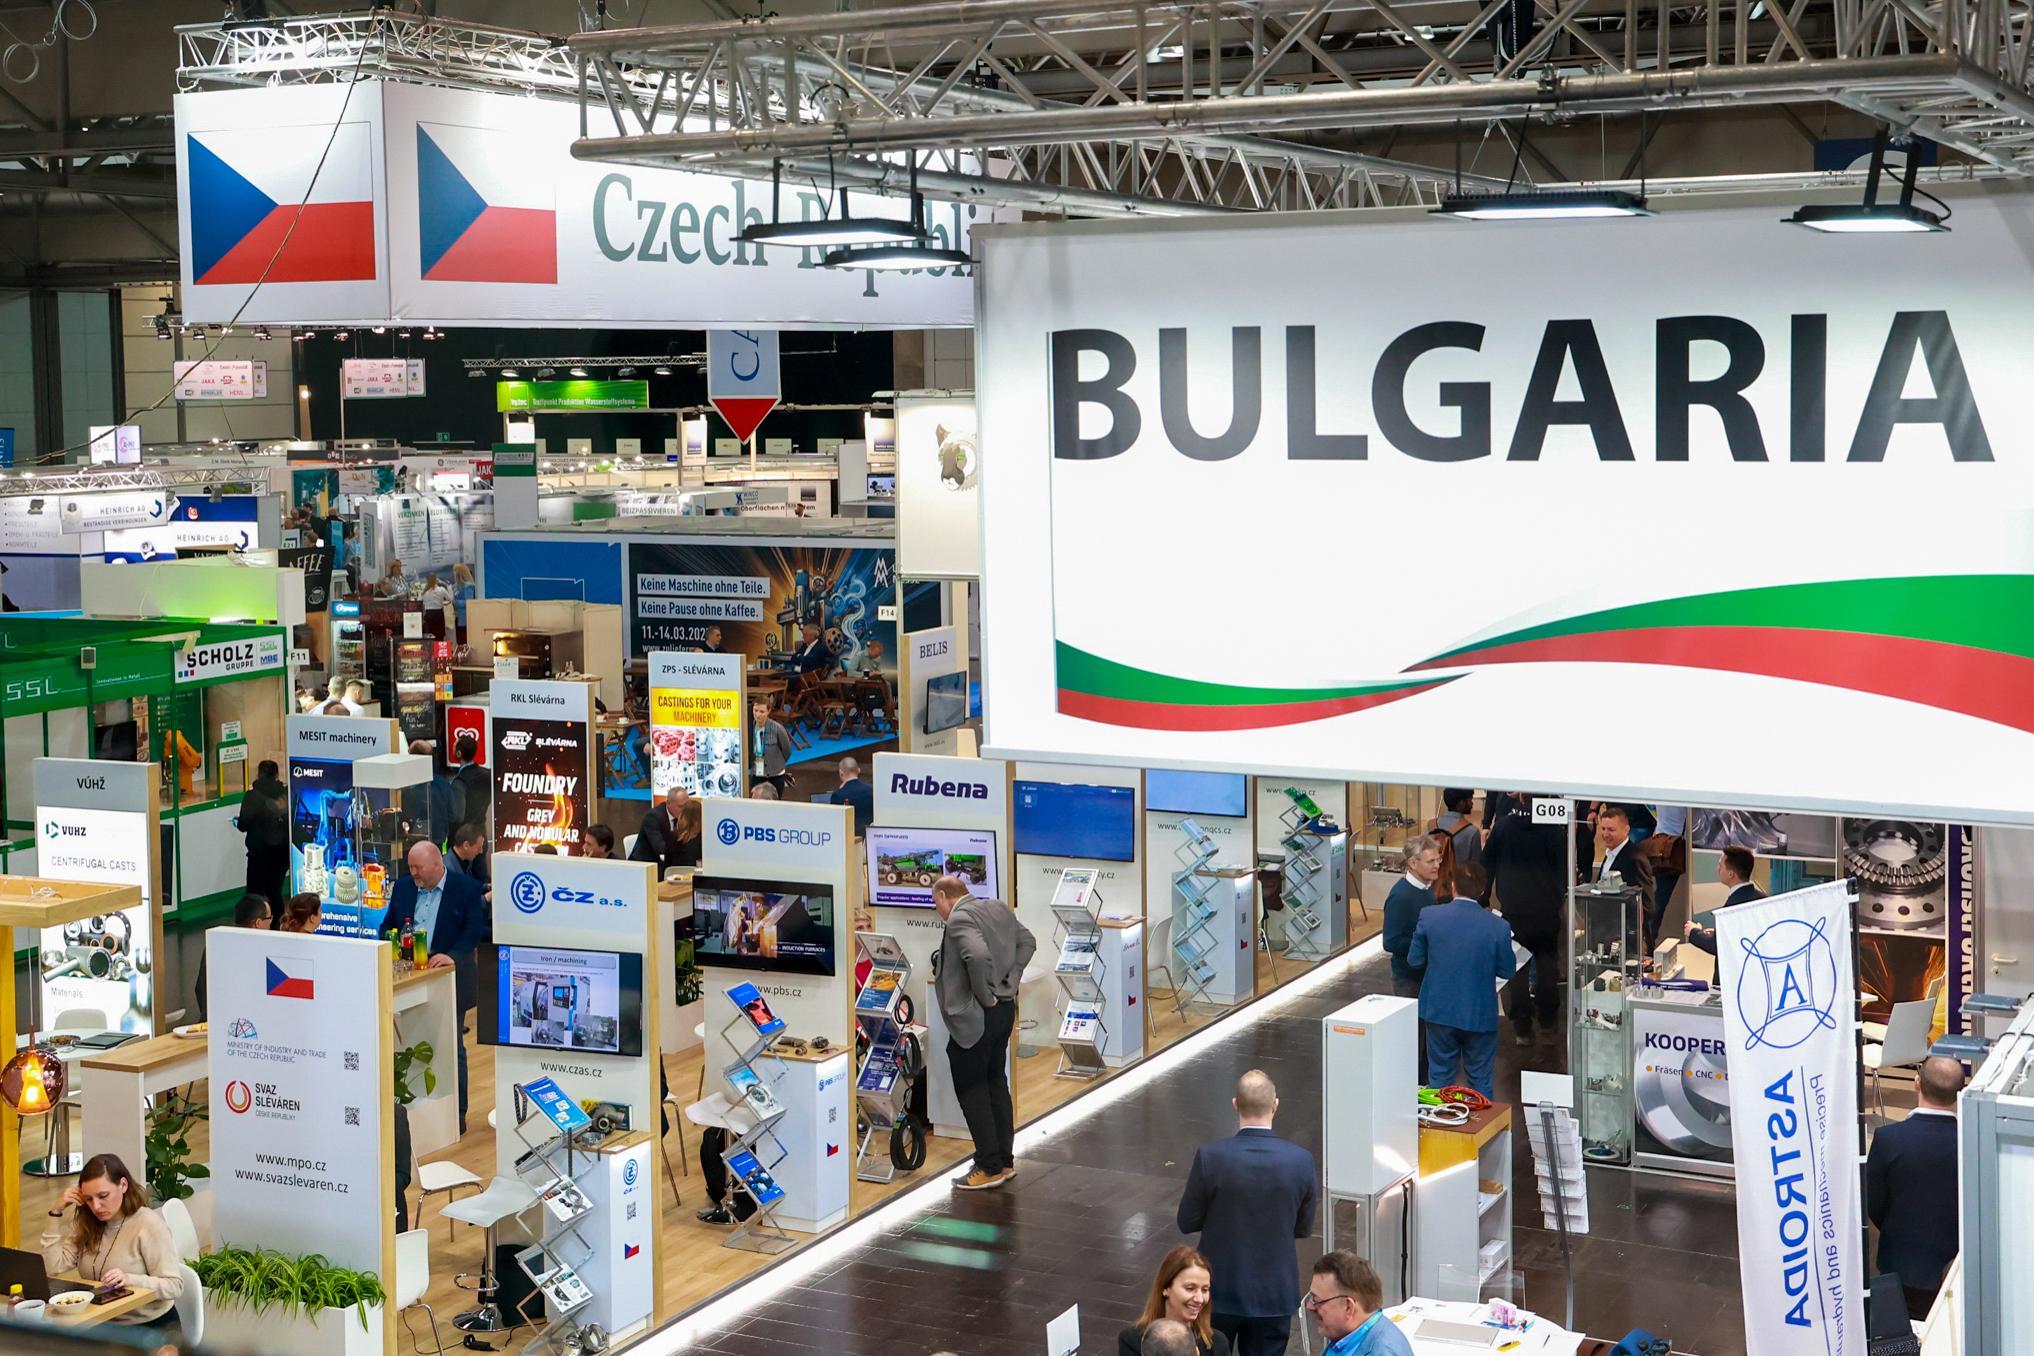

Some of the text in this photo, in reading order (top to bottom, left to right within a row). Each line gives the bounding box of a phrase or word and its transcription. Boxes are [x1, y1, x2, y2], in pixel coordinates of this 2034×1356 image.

[594, 172, 768, 267] Czech
[1051, 310, 1995, 462] BULGARIA
[100, 505, 135, 515] HEINRICH
[177, 534, 215, 542] HEINRICH
[640, 577, 766, 594] Keine Maschine ohne Teile.
[641, 601, 759, 617] Keine Pause ohne Kaffee.
[641, 625, 708, 641] 11.-14.03.202
[187, 643, 254, 669] SCHOLZ
[290, 652, 306, 662] F11
[920, 640, 948, 659] BELIS
[226, 660, 254, 671] GRUPPE
[662, 665, 676, 674] ZPS
[684, 664, 725, 676] SLÉVÁRNA
[7, 678, 59, 701] SSL
[511, 694, 565, 705] RKL Slévárna
[658, 696, 732, 710] CASTINGS FOR YOUR
[674, 711, 717, 724] MACHINERY
[299, 731, 377, 747] MESIT machinery
[535, 737, 577, 748] SLÉVÁRNA
[303, 769, 324, 778] MESIT
[77, 774, 105, 791] VÚHŽ
[502, 772, 578, 797] FOUNDRY
[891, 773, 989, 800] Rubena
[527, 807, 556, 824] GREY
[1536, 804, 1565, 817] G08
[62, 825, 87, 837] VUHZ
[504, 824, 527, 838] AND
[744, 826, 831, 847] PBS GROUP
[52, 856, 138, 872] CENTRIFUGAL CASTS
[552, 886, 628, 908] ČZ a.s.
[557, 957, 587, 966] machining
[227, 1040, 328, 1059] MINISTRY OF INDUSTRY AND TRADE
[227, 1048, 296, 1064] OF THE CZECH REPUBLIC
[541, 1062, 603, 1078] www.czas.cz
[1655, 1065, 1683, 1077] Fräsen
[1695, 1069, 1713, 1079] CNC
[255, 1083, 277, 1096] SVAZ
[255, 1095, 301, 1112] SLÉVÁREN
[255, 1153, 327, 1171] www.mpo.cz
[235, 1169, 349, 1194] www.svazslevaren.cz
